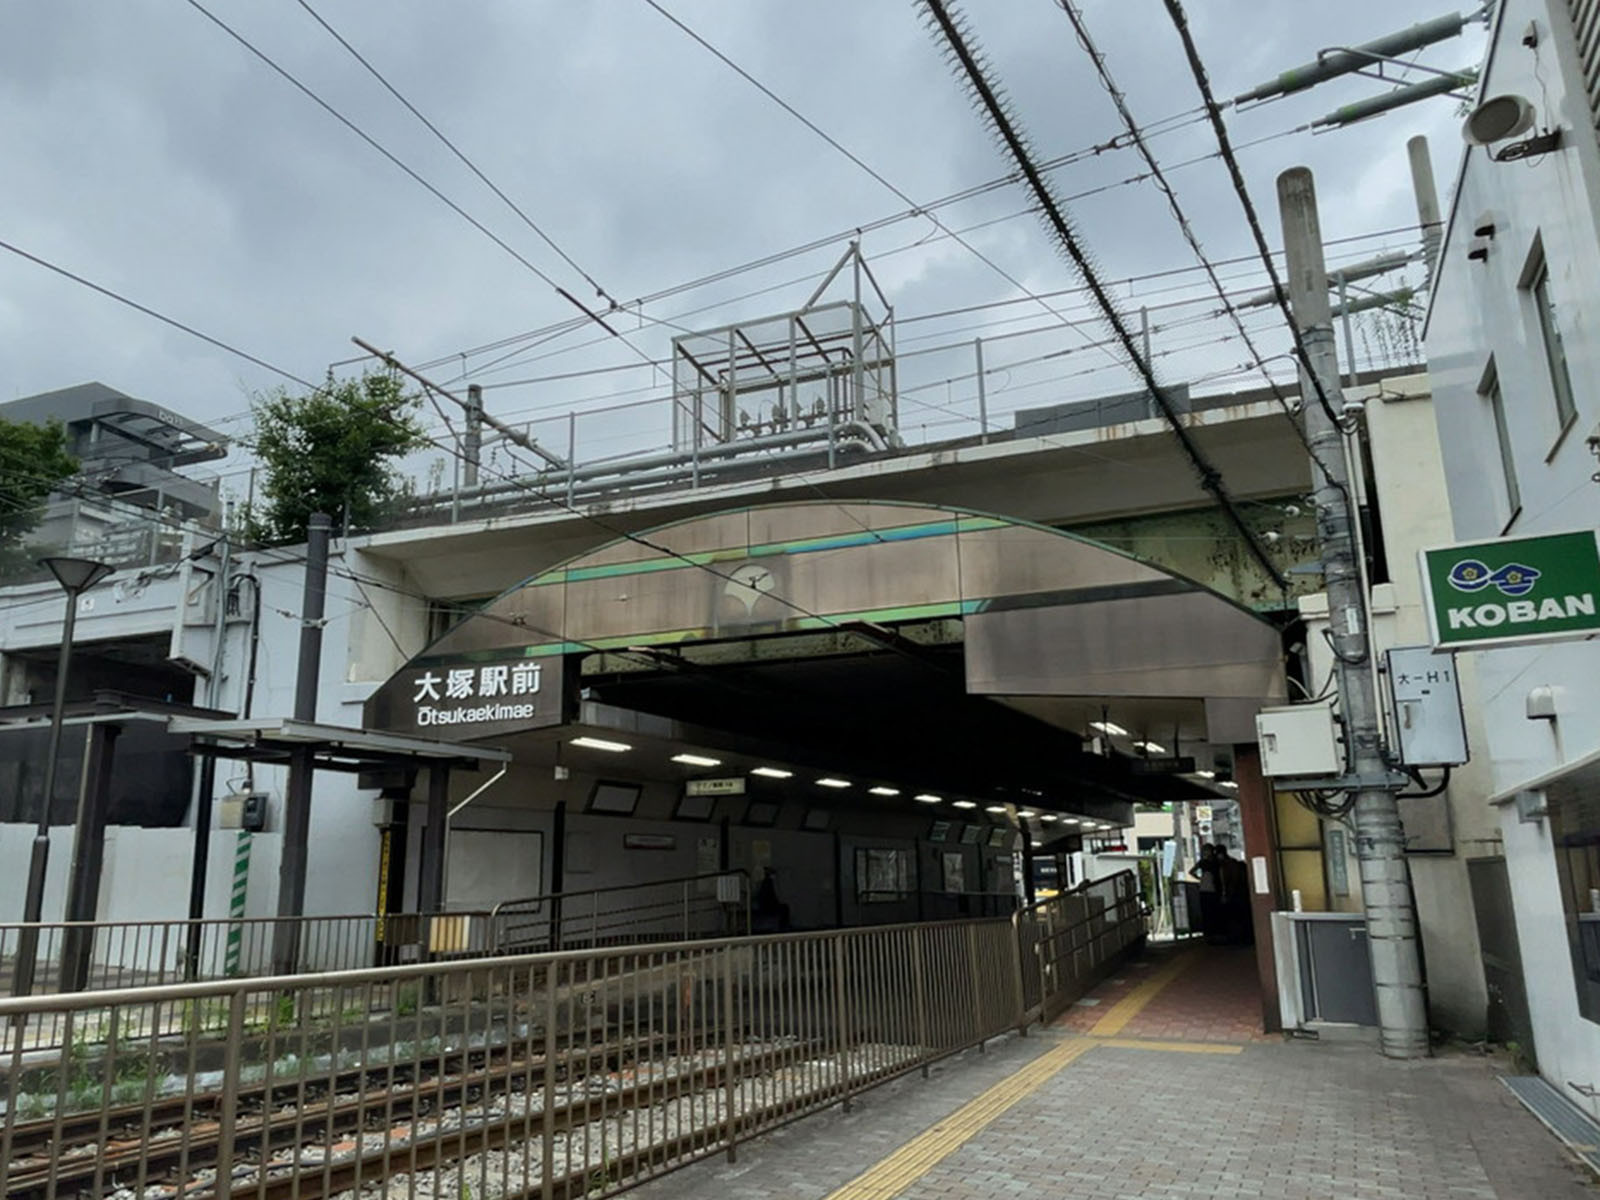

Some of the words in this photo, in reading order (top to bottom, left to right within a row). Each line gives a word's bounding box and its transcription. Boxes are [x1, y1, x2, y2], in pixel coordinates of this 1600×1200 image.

[1447, 593, 1596, 629] KOBAN
[413, 662, 541, 702] 大塚駅前
